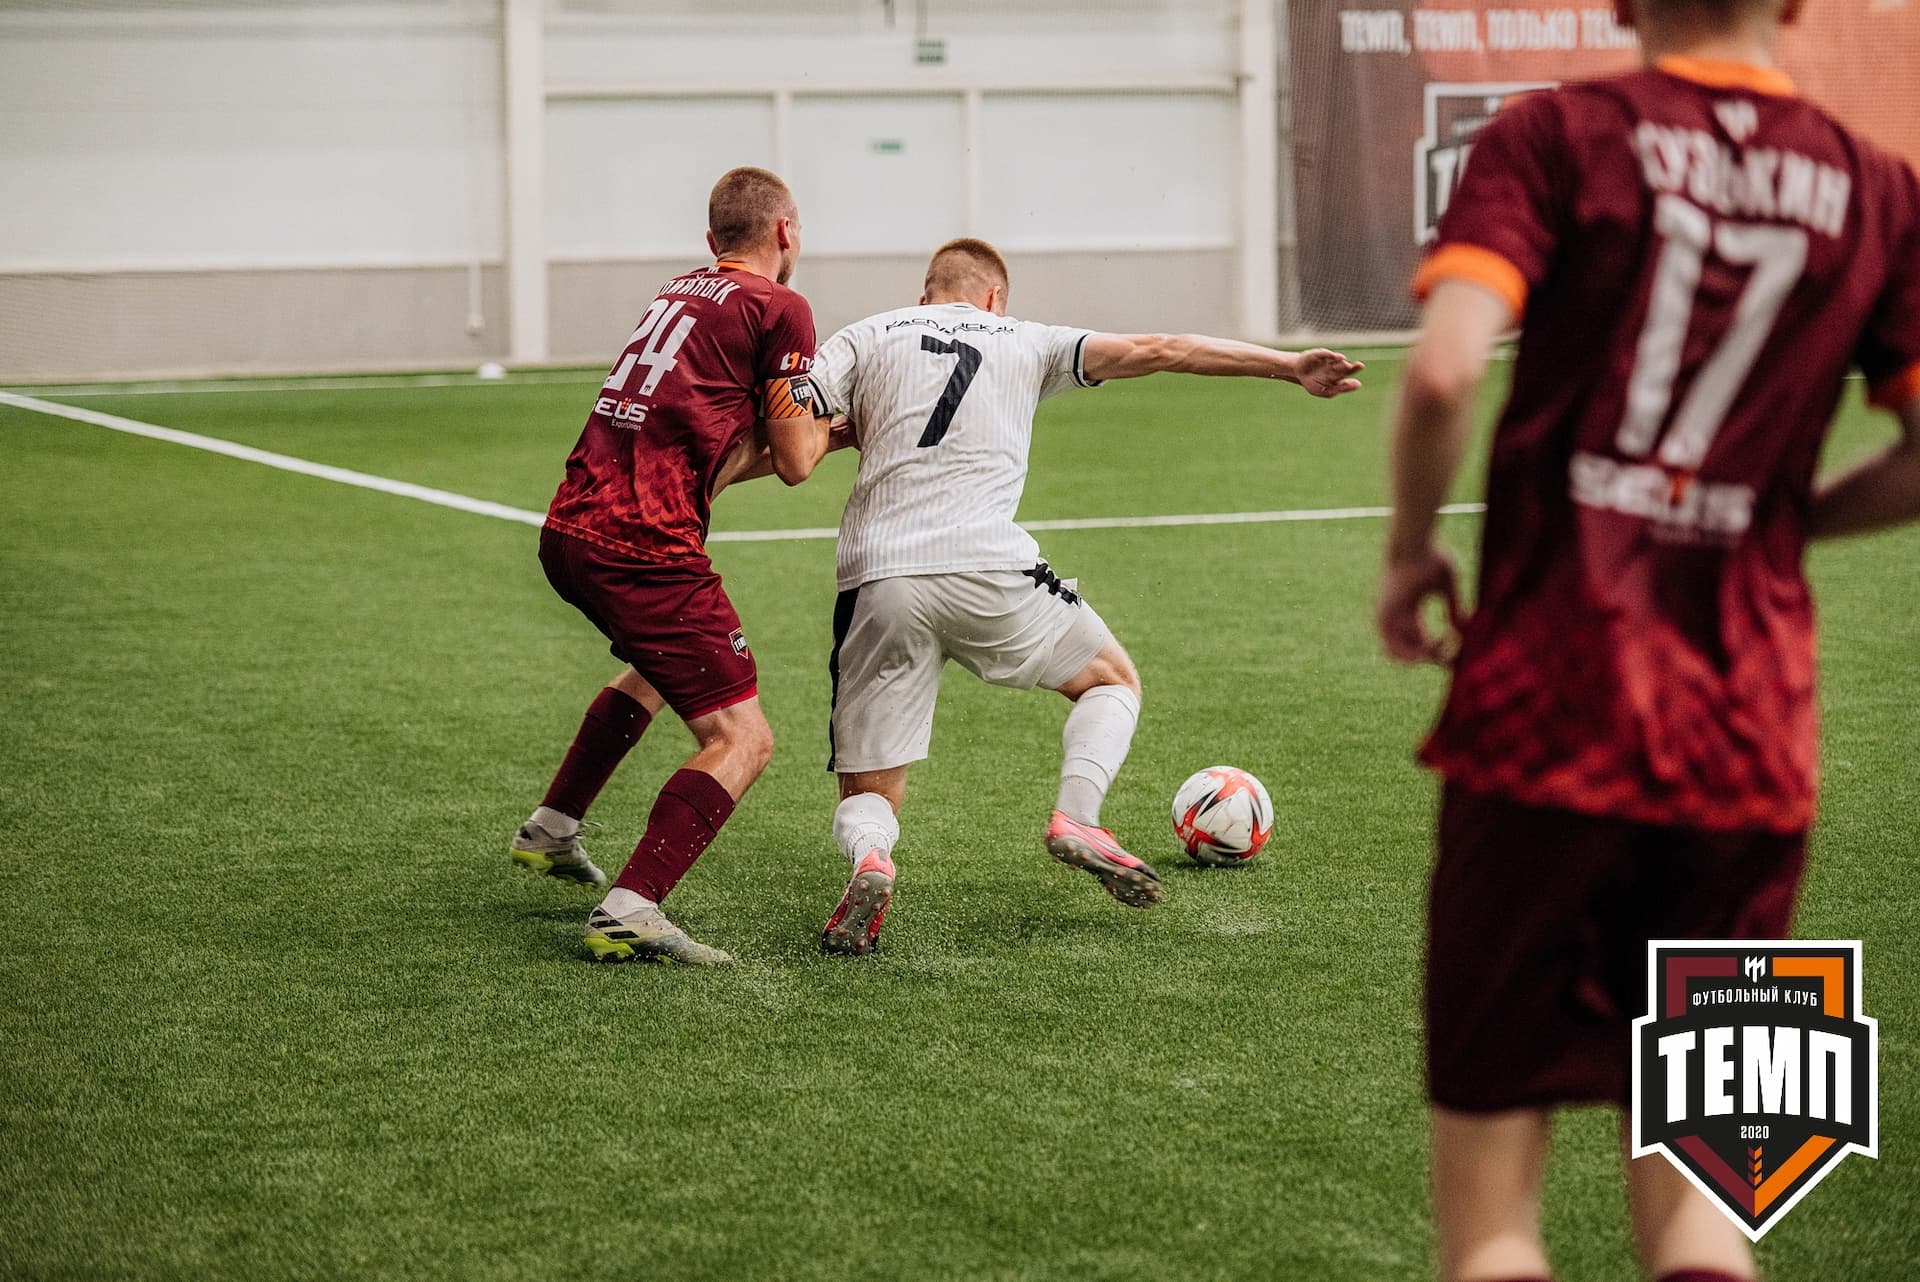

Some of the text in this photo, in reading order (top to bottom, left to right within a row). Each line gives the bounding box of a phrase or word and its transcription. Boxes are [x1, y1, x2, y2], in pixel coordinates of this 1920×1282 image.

[601, 299, 697, 397] 24
[1616, 192, 1808, 466] 17
[917, 334, 982, 448] 7
